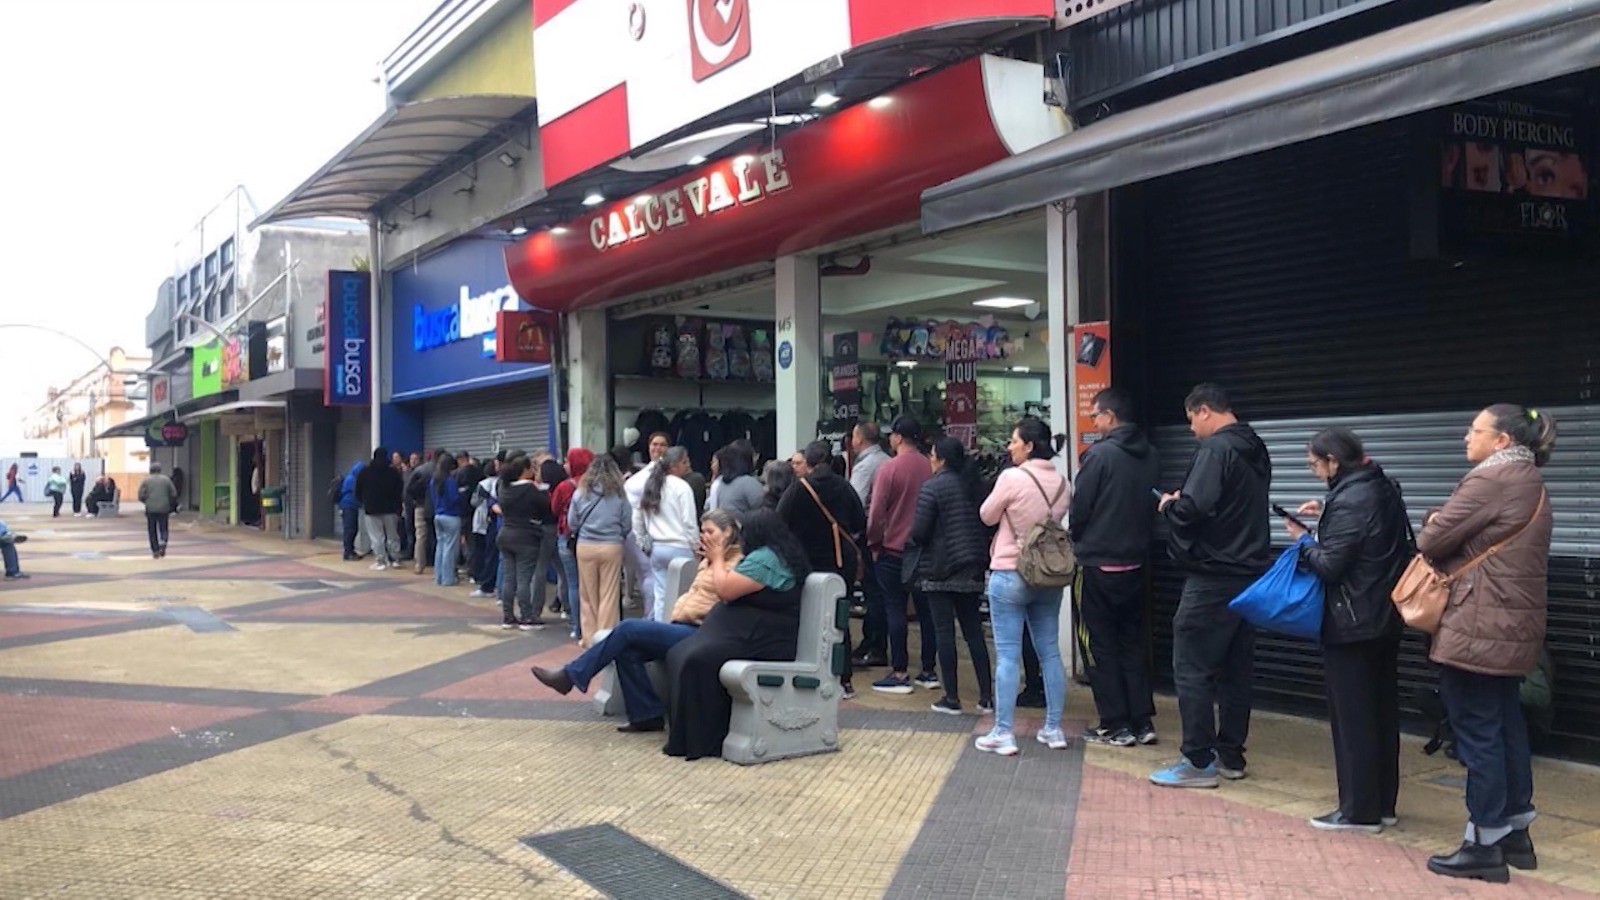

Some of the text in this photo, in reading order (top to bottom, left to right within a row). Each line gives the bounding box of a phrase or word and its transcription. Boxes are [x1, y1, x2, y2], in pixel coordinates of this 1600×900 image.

[1453, 112, 1575, 148] BODY PIERCING
[945, 339, 976, 360] MEGA
